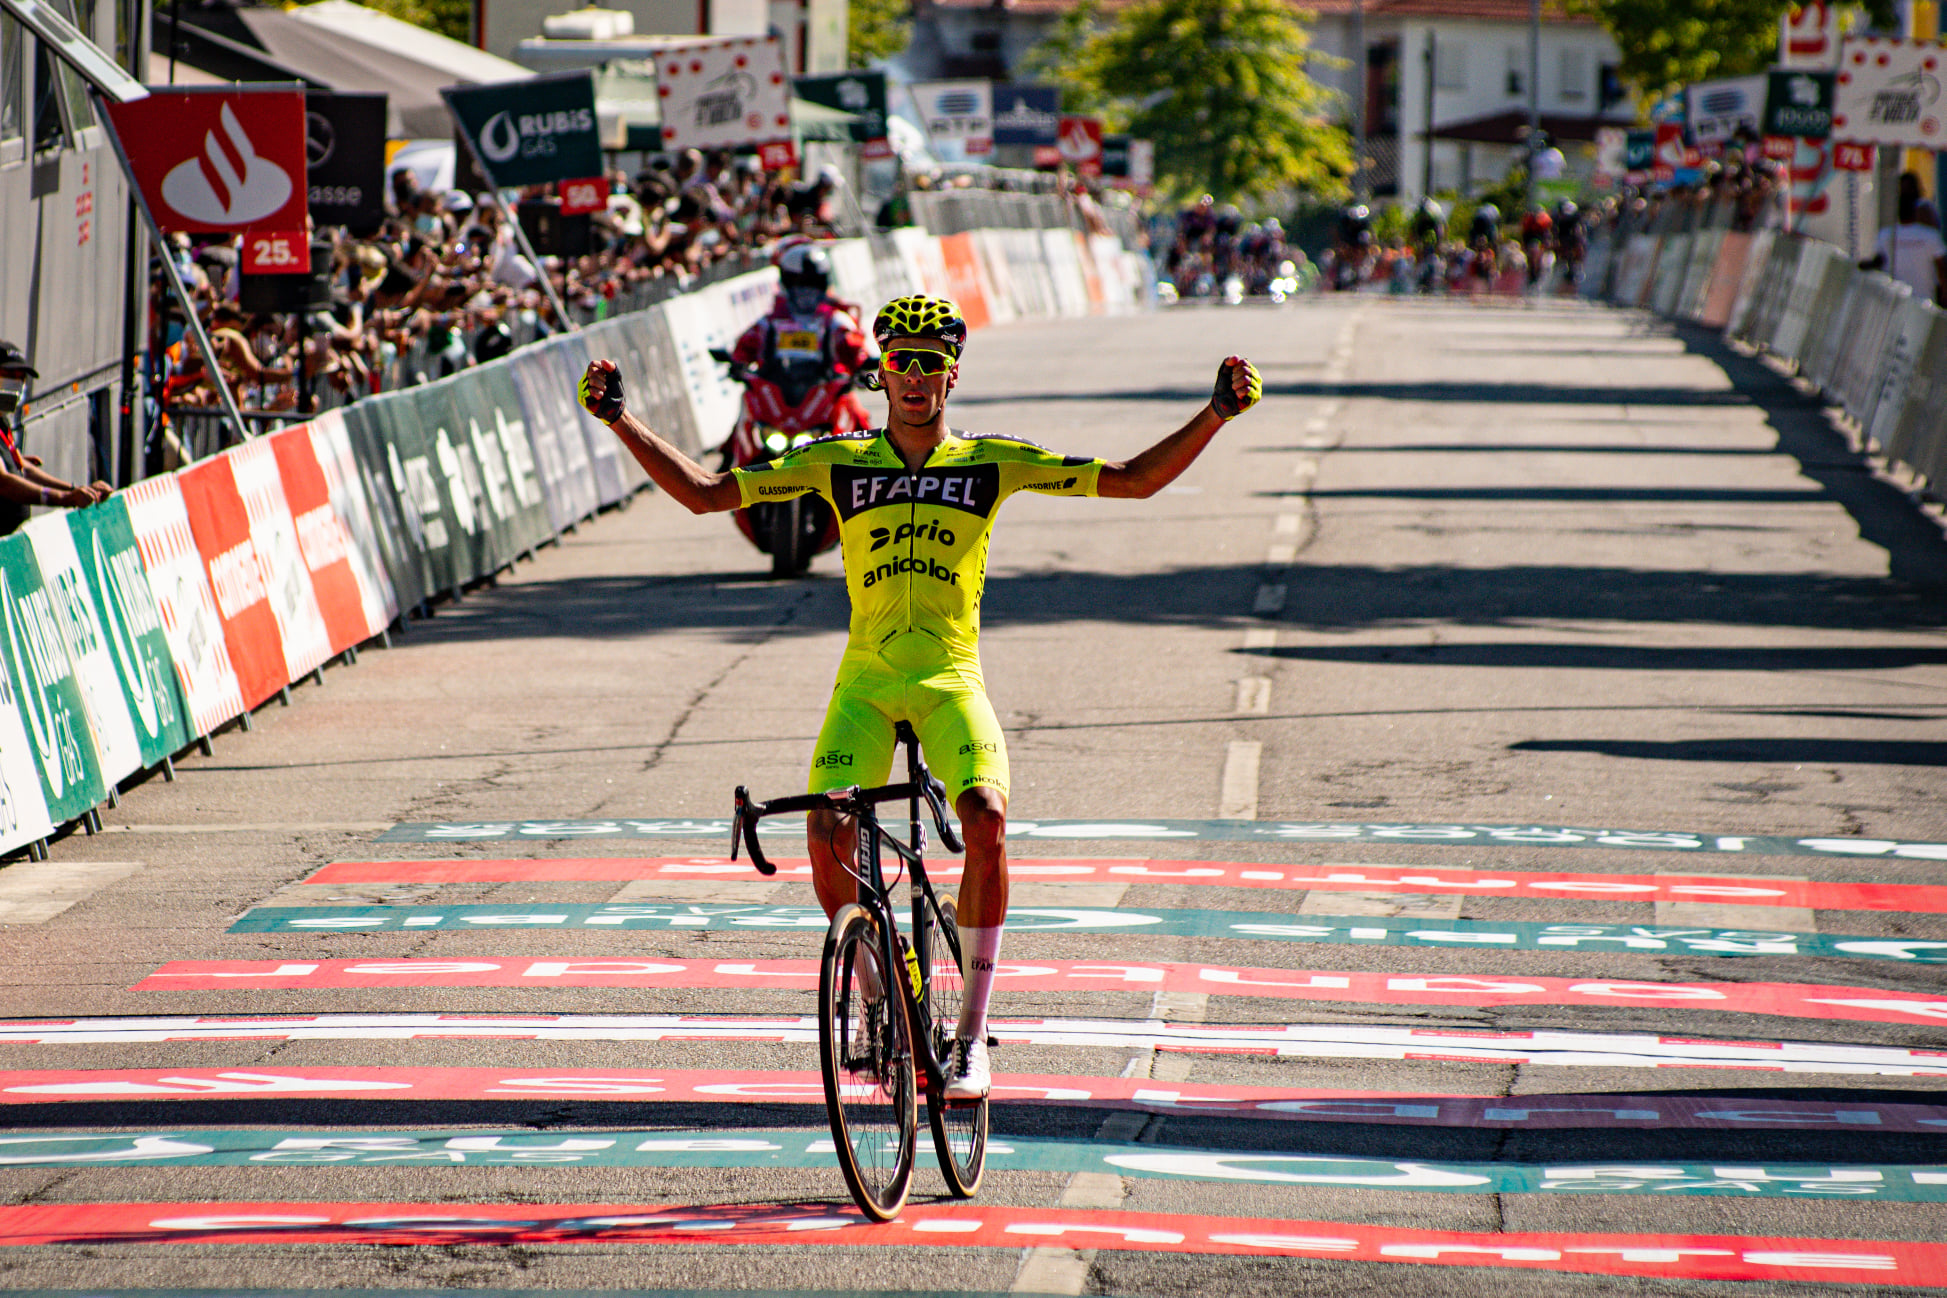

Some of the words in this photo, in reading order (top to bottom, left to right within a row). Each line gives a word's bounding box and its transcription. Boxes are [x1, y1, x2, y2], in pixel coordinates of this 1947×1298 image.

[309, 186, 362, 206] asse
[758, 485, 805, 495] GLASSDRIVE
[852, 476, 976, 507] EFAPEL
[893, 519, 956, 546] prio
[863, 556, 961, 588] anicolor
[816, 753, 853, 768] asd
[860, 827, 871, 886] GIANT
